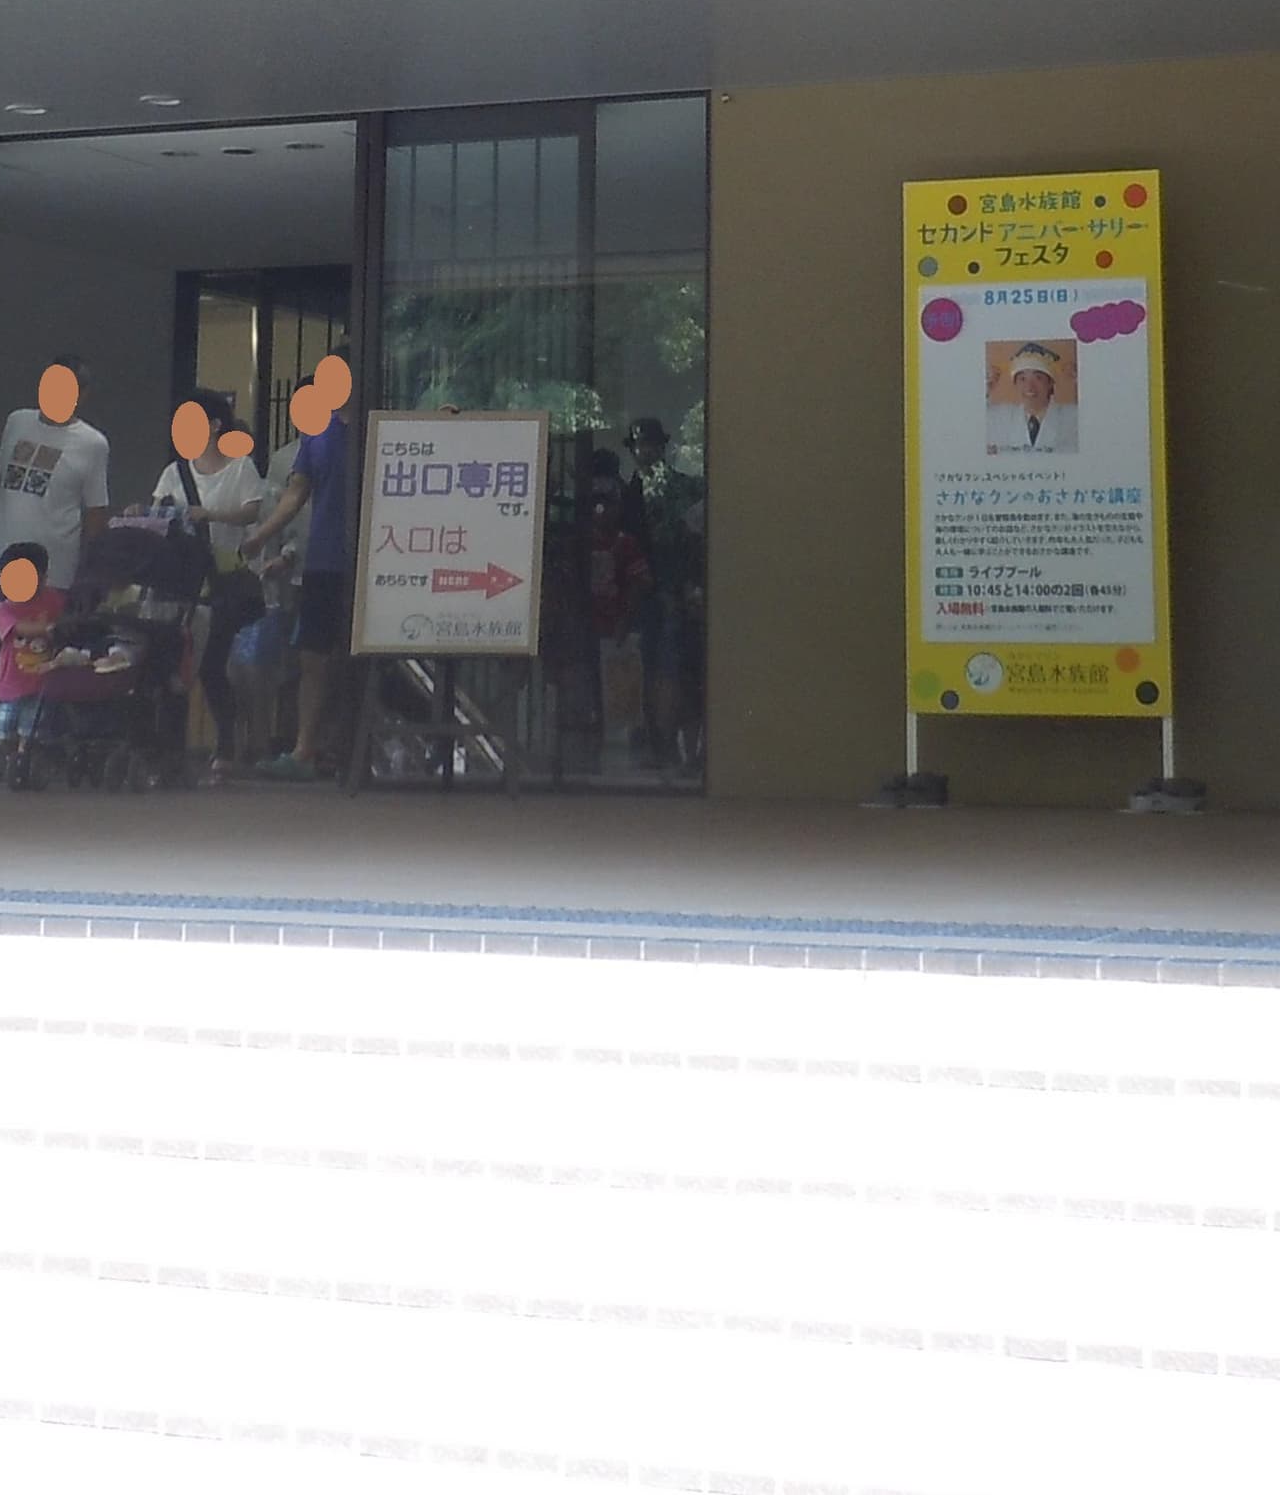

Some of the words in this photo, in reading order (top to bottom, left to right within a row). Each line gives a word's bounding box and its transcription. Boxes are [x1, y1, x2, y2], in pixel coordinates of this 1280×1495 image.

[979, 190, 1082, 213] 宮島水族館
[917, 217, 1148, 245] セカンドアニバーサリー
[995, 243, 1070, 266] フェスタ
[381, 442, 435, 456] こちらは
[382, 460, 530, 498] 出口専用
[935, 487, 1143, 506] さかなクンのおさかな講座
[376, 525, 468, 555] 入口は
